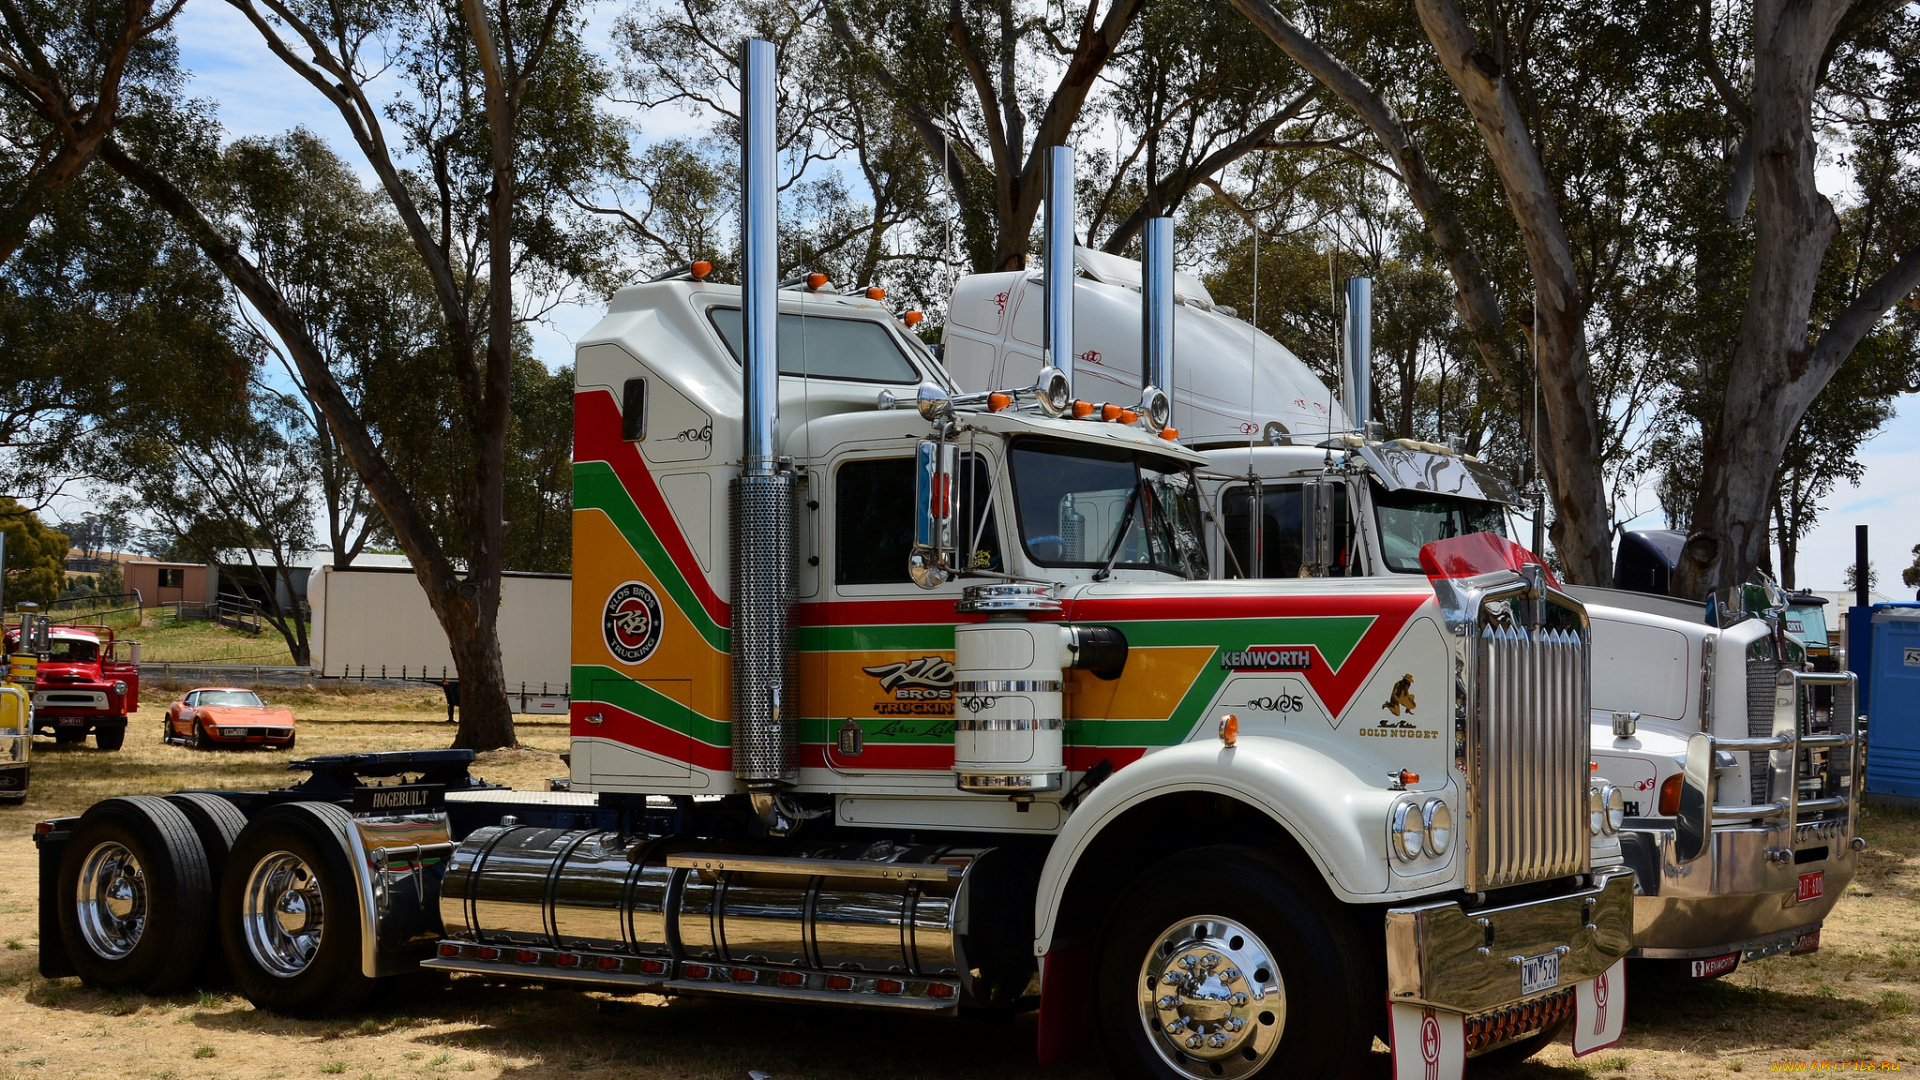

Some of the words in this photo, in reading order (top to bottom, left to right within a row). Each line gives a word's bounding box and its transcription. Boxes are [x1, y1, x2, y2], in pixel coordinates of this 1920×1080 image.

[609, 587, 630, 610] KLOS
[632, 587, 656, 609] BROS
[611, 638, 656, 659] TRUCKING
[1221, 650, 1310, 667] KENWORTH
[895, 689, 953, 701] BROS
[873, 702, 955, 715] TRUCKIN
[1359, 728, 1388, 738] GOLD
[1390, 729, 1439, 740] NUGGET
[372, 790, 429, 808] HOGEBUILT
[1543, 957, 1557, 981] 528
